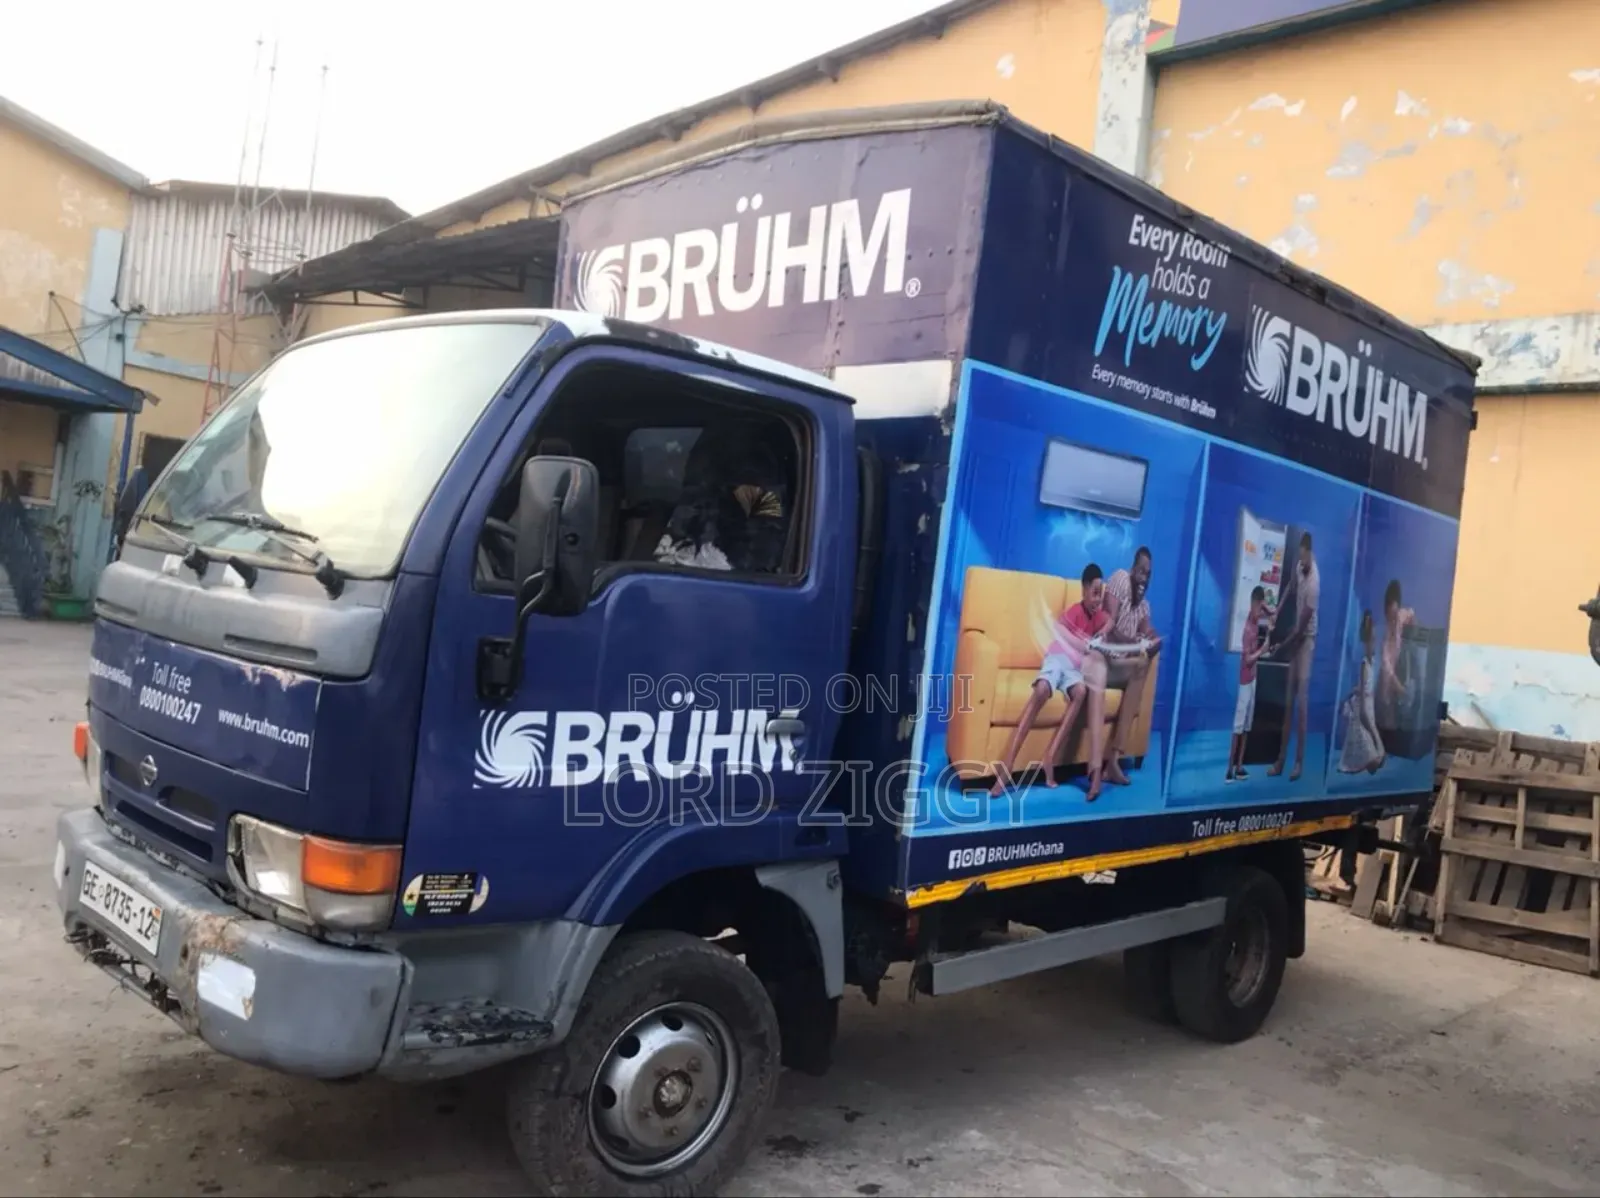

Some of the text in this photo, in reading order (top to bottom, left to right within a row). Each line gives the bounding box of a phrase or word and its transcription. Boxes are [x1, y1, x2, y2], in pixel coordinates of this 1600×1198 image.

[624, 188, 912, 323] BRÜHM
[1128, 213, 1229, 268] Every Room
[1151, 258, 1211, 299] holds a
[1094, 265, 1227, 371] Memory
[1092, 364, 1117, 388] Every
[1116, 375, 1151, 400] memory
[1151, 386, 1173, 404] starts
[1173, 394, 1190, 410] with
[1286, 326, 1427, 464] BRÜHM
[152, 662, 170, 686] Toll
[168, 666, 192, 694] free
[140, 685, 202, 725] 0800100247
[218, 709, 309, 748] www.bruhm.com
[550, 691, 799, 787] BRÜHM
[1192, 819, 1213, 838] Toll
[1213, 817, 1237, 835] free
[988, 841, 1064, 863] BRUHMGhana
[83, 869, 99, 901] GE
